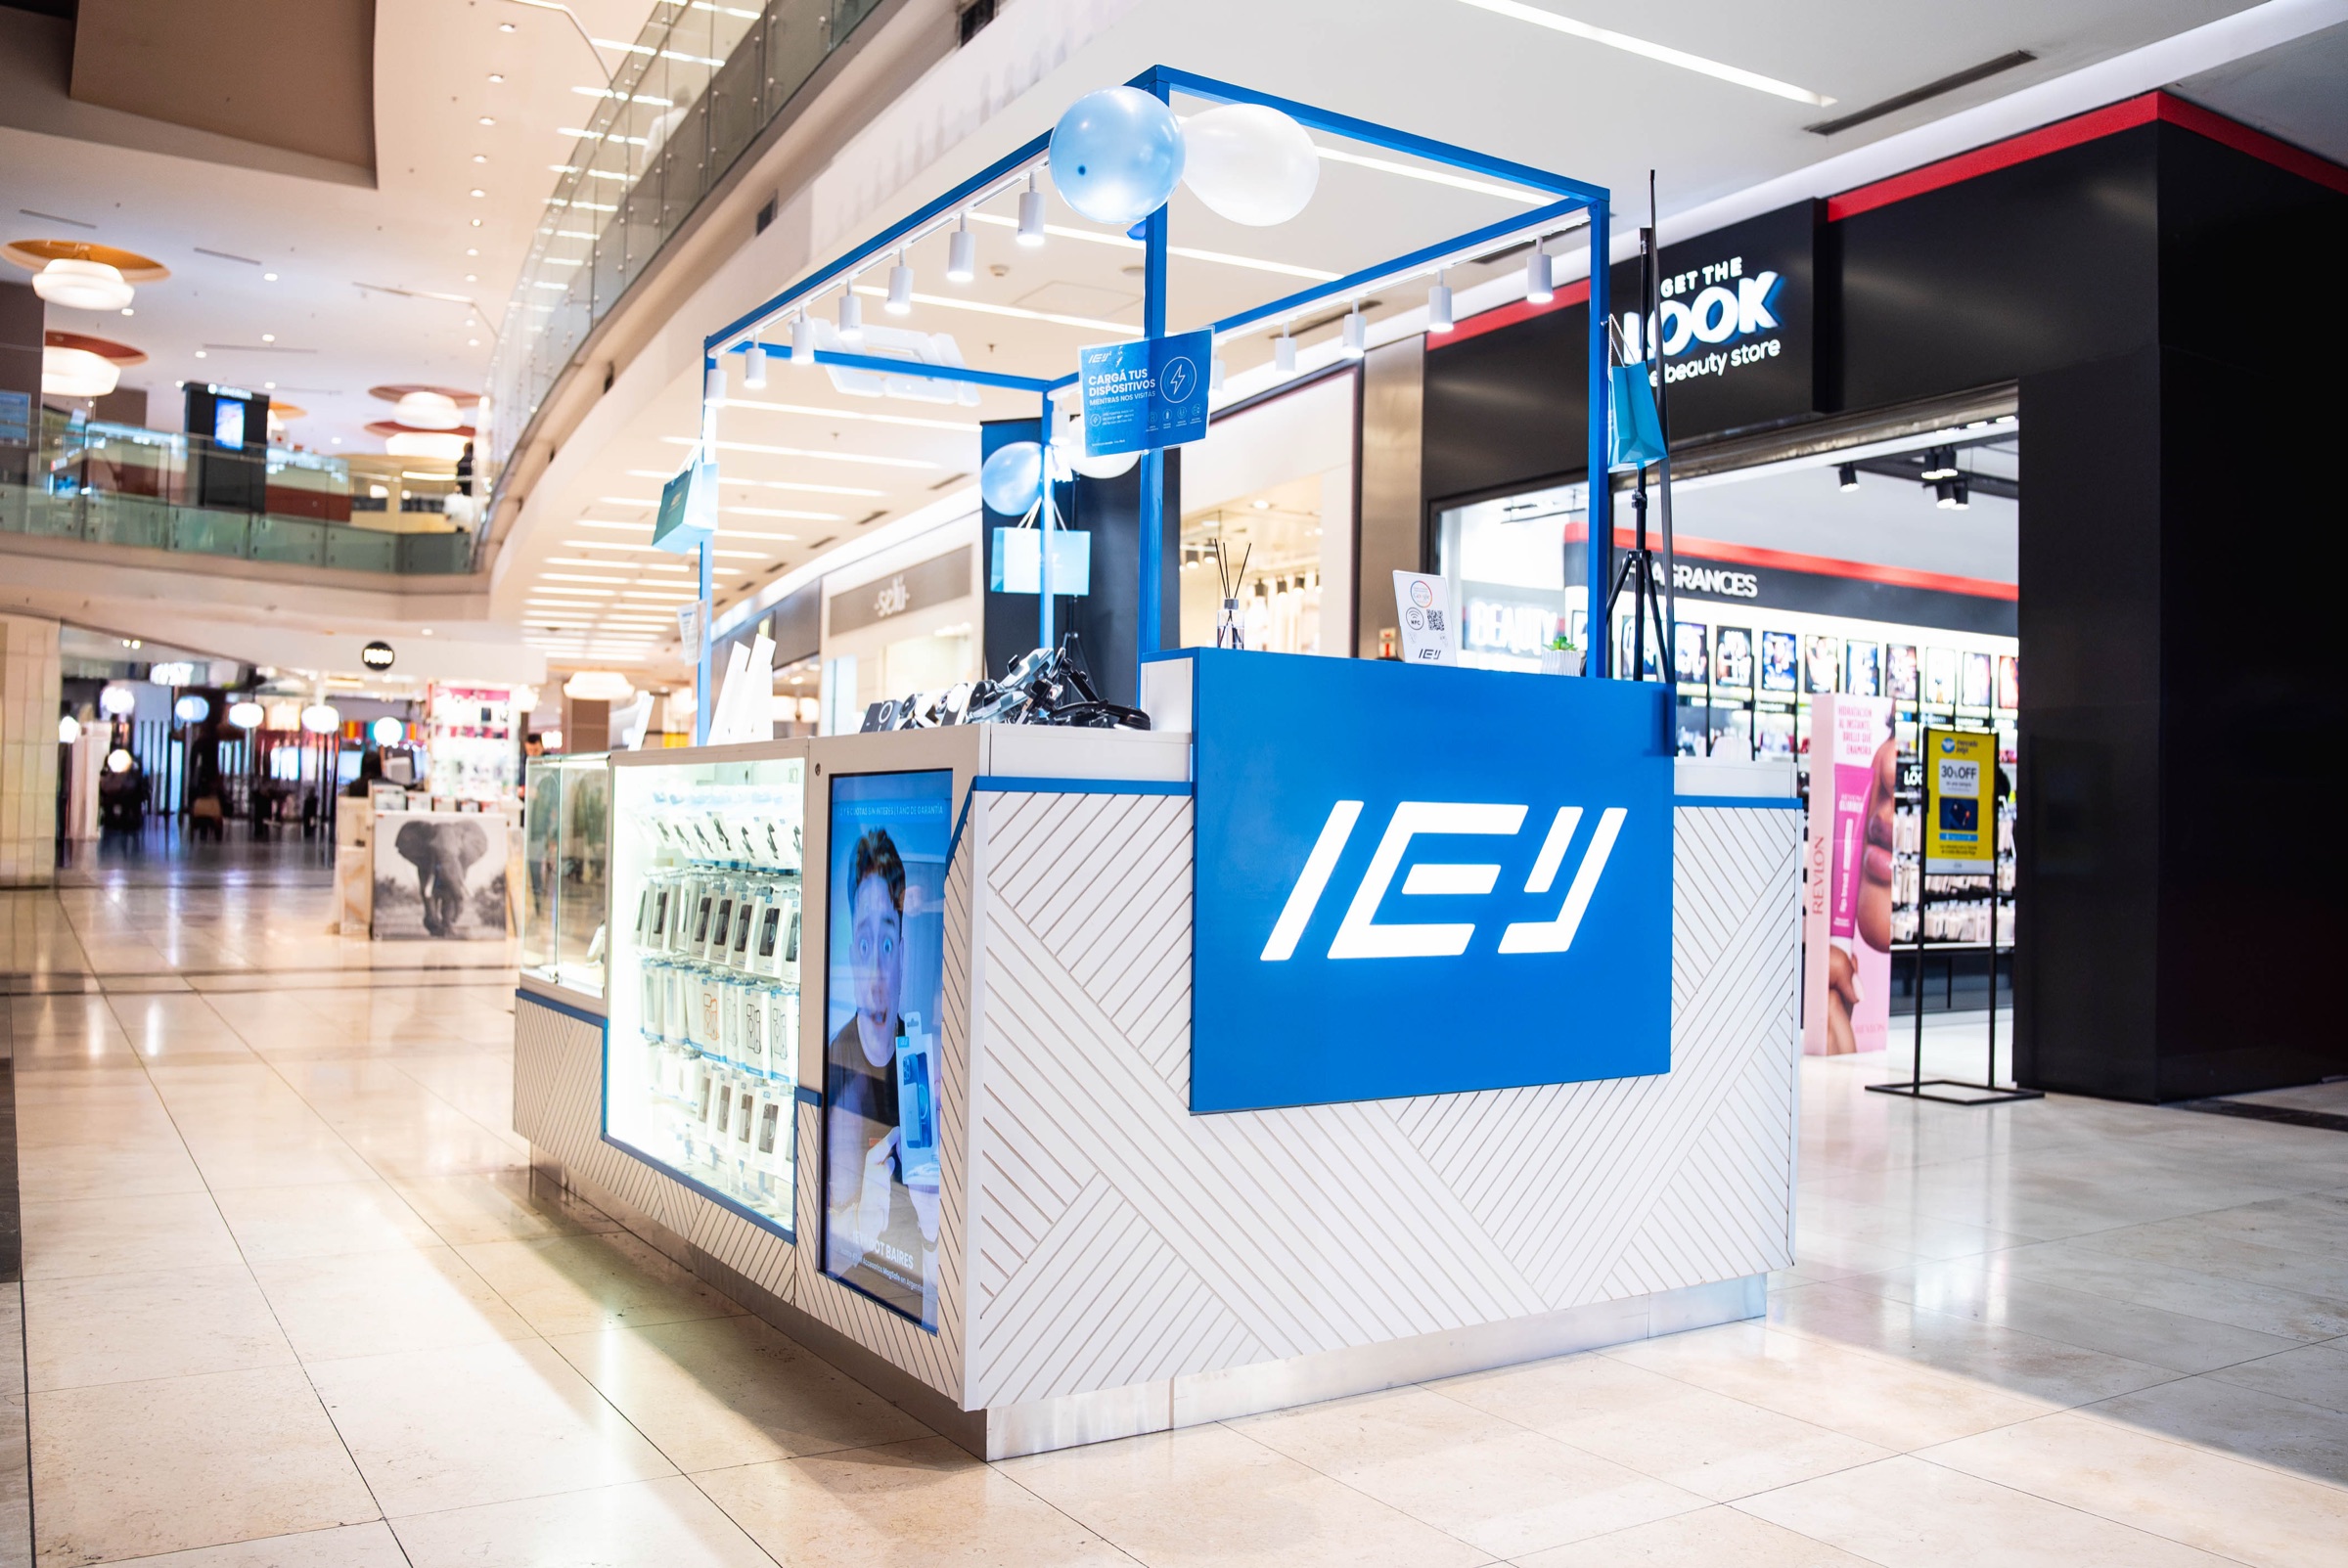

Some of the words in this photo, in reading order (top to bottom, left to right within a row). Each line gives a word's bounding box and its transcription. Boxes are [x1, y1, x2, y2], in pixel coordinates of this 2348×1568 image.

[1660, 270, 1698, 298] GET
[1701, 256, 1742, 286] THE
[1623, 270, 1780, 365] LOOK
[1089, 368, 1127, 385] CARGÁ
[1128, 368, 1148, 381] TUS
[1664, 351, 1728, 383] beauty
[1730, 338, 1781, 367] store
[1089, 379, 1156, 397] DISPOSITIVOS
[1089, 395, 1119, 406] MIENTRAS
[1120, 392, 1134, 402] NOS
[1134, 390, 1156, 400] VISITAS
[1621, 557, 1758, 598] FARANCES
[1468, 600, 1558, 656] BEAUTY
[1812, 836, 1824, 915] REVLON
[885, 1243, 914, 1270] BAIRES
